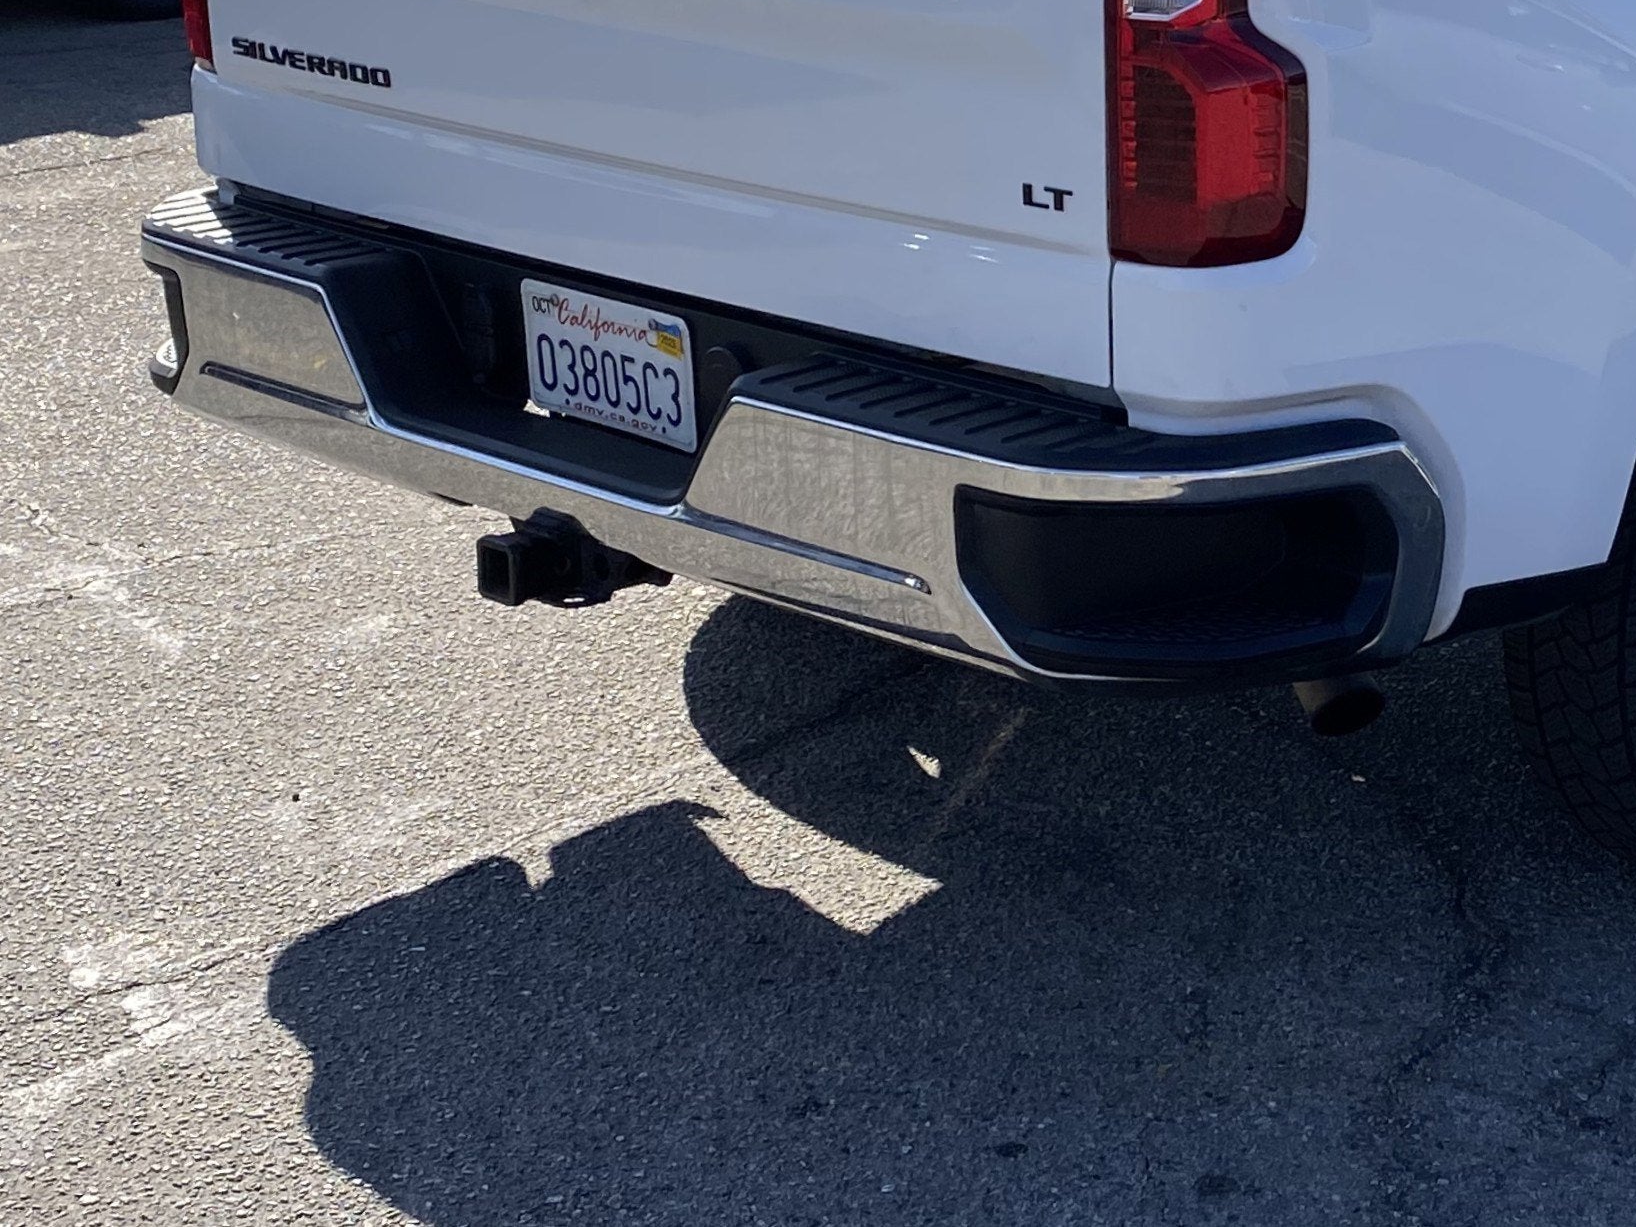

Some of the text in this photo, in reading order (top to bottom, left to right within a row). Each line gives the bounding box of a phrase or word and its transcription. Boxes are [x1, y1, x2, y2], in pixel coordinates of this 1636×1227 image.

[231, 35, 392, 90] SILVERADO
[1022, 182, 1074, 212] LT
[531, 295, 551, 315] OCT
[556, 297, 649, 342] California
[536, 332, 683, 428] 03805C3
[573, 401, 658, 434] dmv.ca.gov
